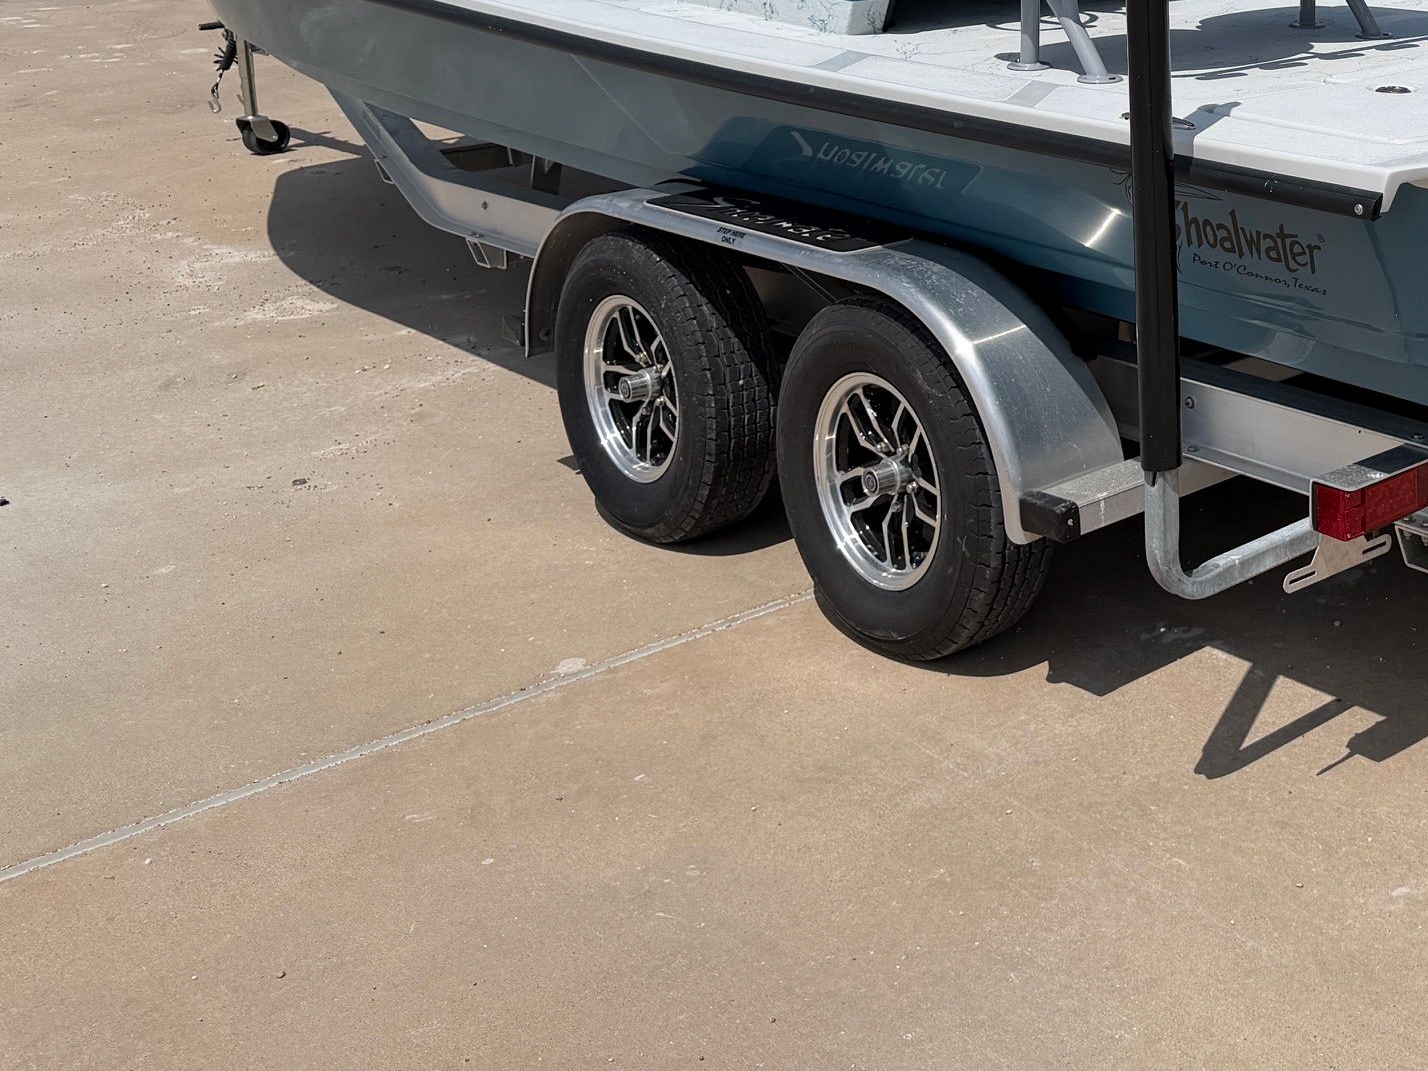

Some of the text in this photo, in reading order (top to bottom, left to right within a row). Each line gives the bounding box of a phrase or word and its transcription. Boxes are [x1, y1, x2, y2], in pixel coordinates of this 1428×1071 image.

[1175, 199, 1323, 275] hoalwater
[1192, 252, 1219, 270] Port
[1292, 277, 1328, 296] Texas
